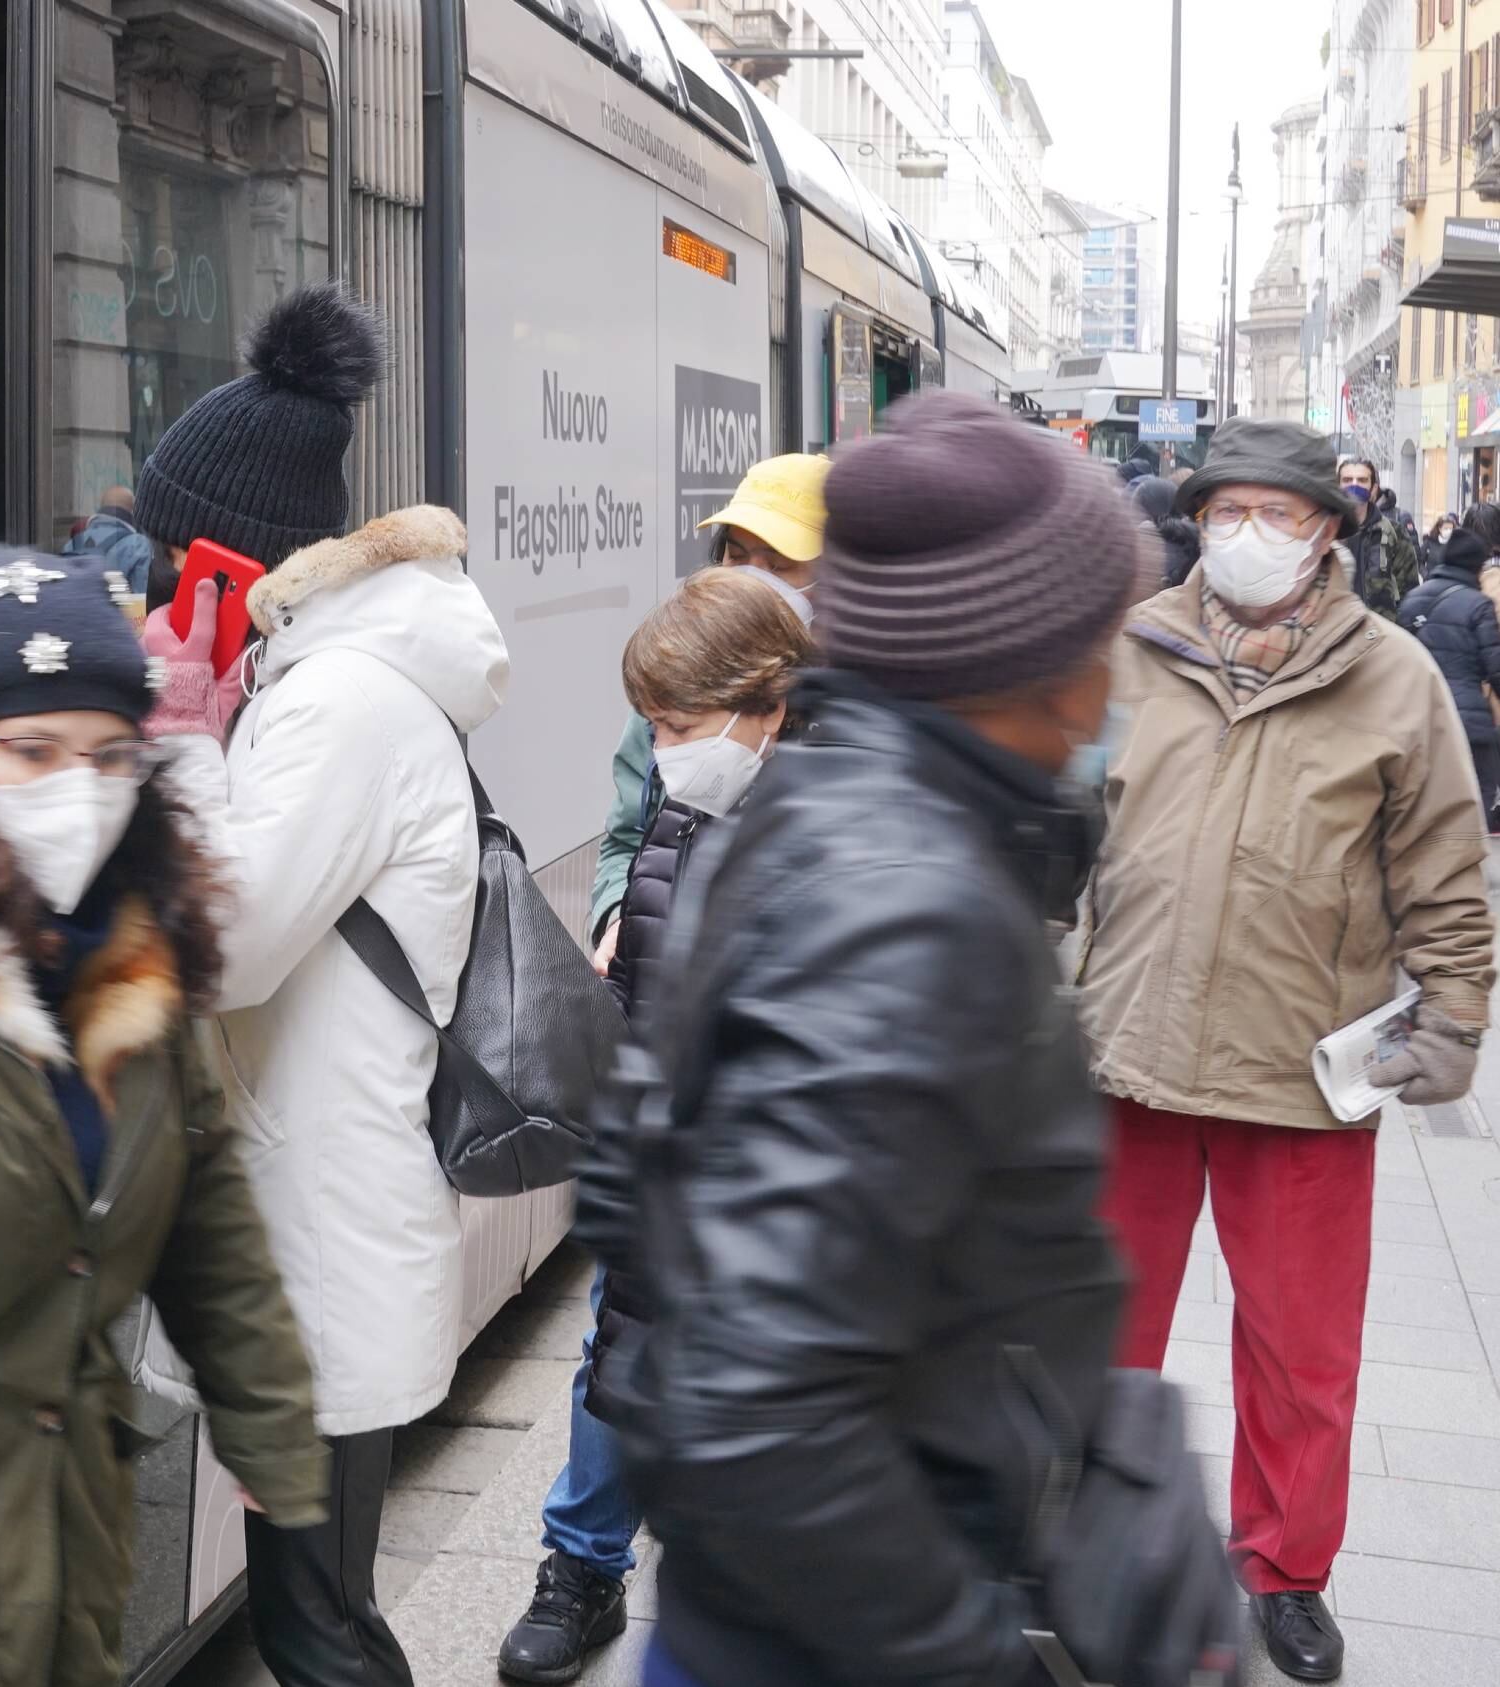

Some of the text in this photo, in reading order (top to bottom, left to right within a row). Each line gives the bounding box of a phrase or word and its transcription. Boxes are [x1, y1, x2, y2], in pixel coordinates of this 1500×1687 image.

[601, 102, 708, 191] maisonsdumonde.com
[543, 368, 607, 444] Nuovo
[681, 402, 757, 475] MAISONS
[1140, 423, 1195, 434] RALLENTAMENTO
[1156, 407, 1179, 422] FINE
[494, 485, 589, 576] Flagship
[595, 484, 643, 551] Store
[681, 504, 700, 540] DU
